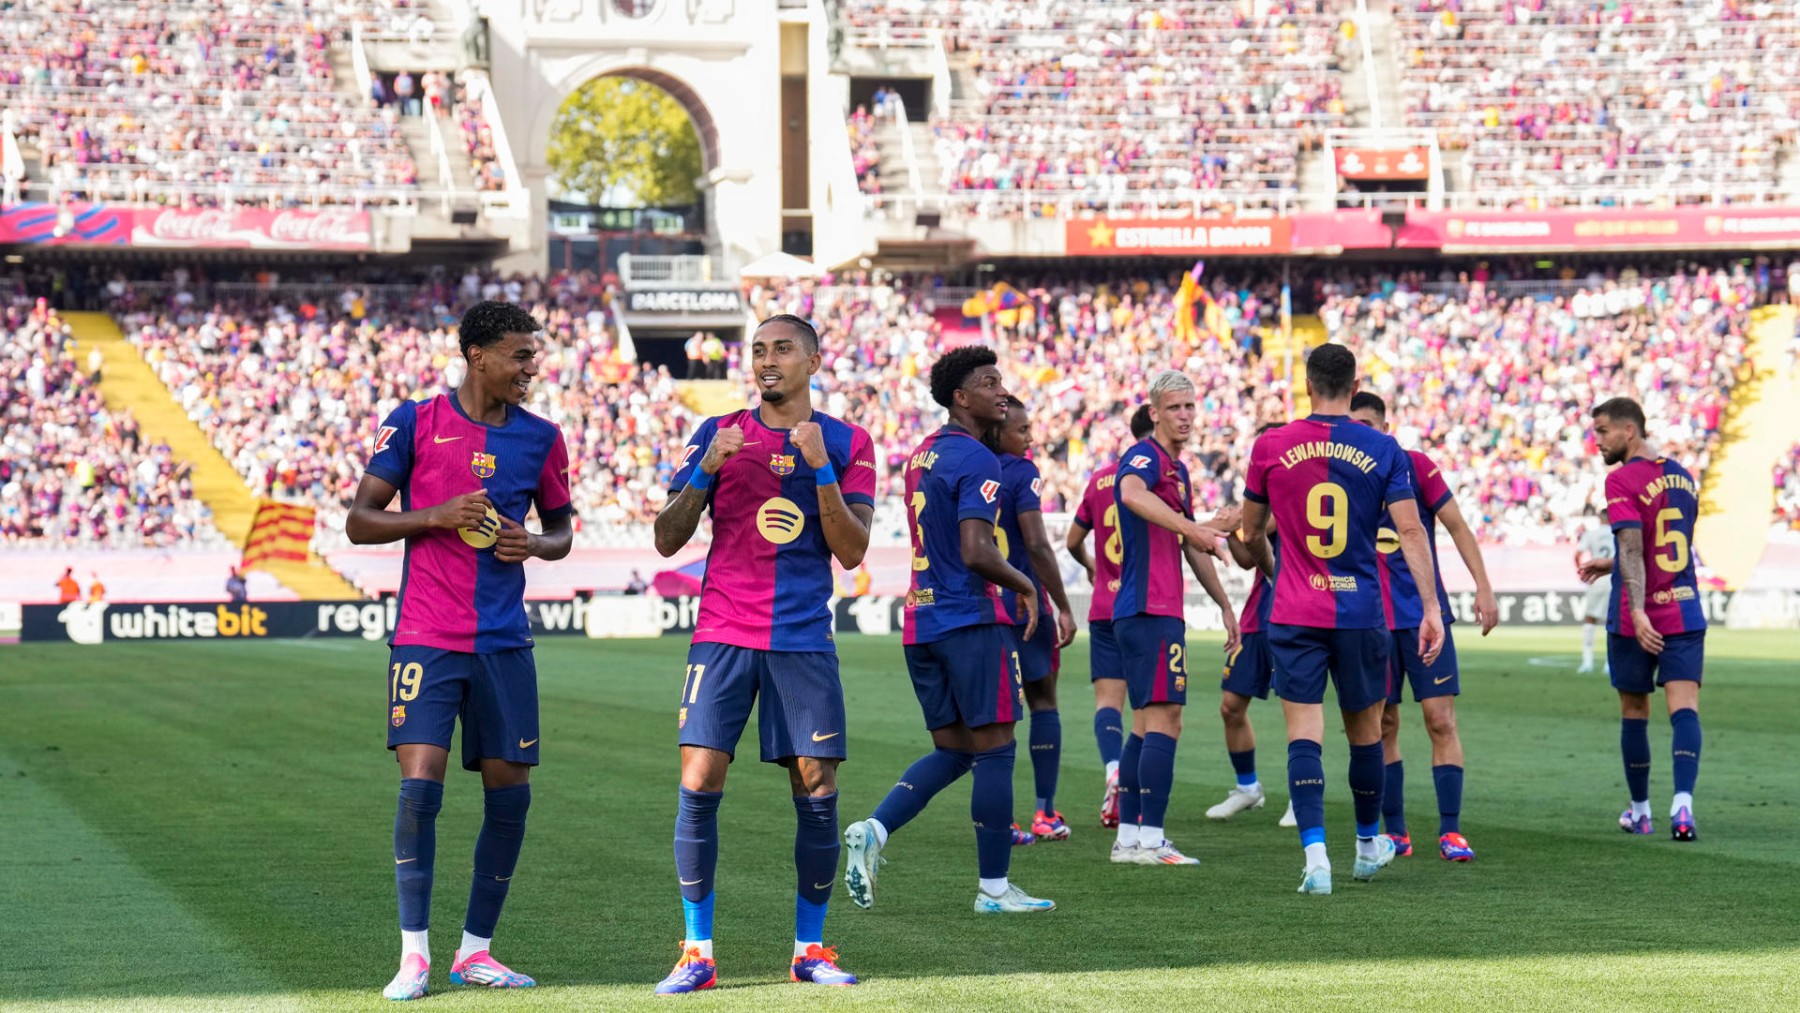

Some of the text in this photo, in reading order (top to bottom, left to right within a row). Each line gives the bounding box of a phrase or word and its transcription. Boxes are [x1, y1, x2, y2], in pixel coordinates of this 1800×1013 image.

[1279, 441, 1378, 474] LEWANDOWSKI
[1306, 481, 1349, 559] 9
[1654, 507, 1689, 573] 5
[110, 605, 267, 638] whitebit
[318, 597, 397, 640] regi
[1522, 591, 1563, 622] at
[392, 661, 424, 702] 19
[681, 663, 706, 704] 11
